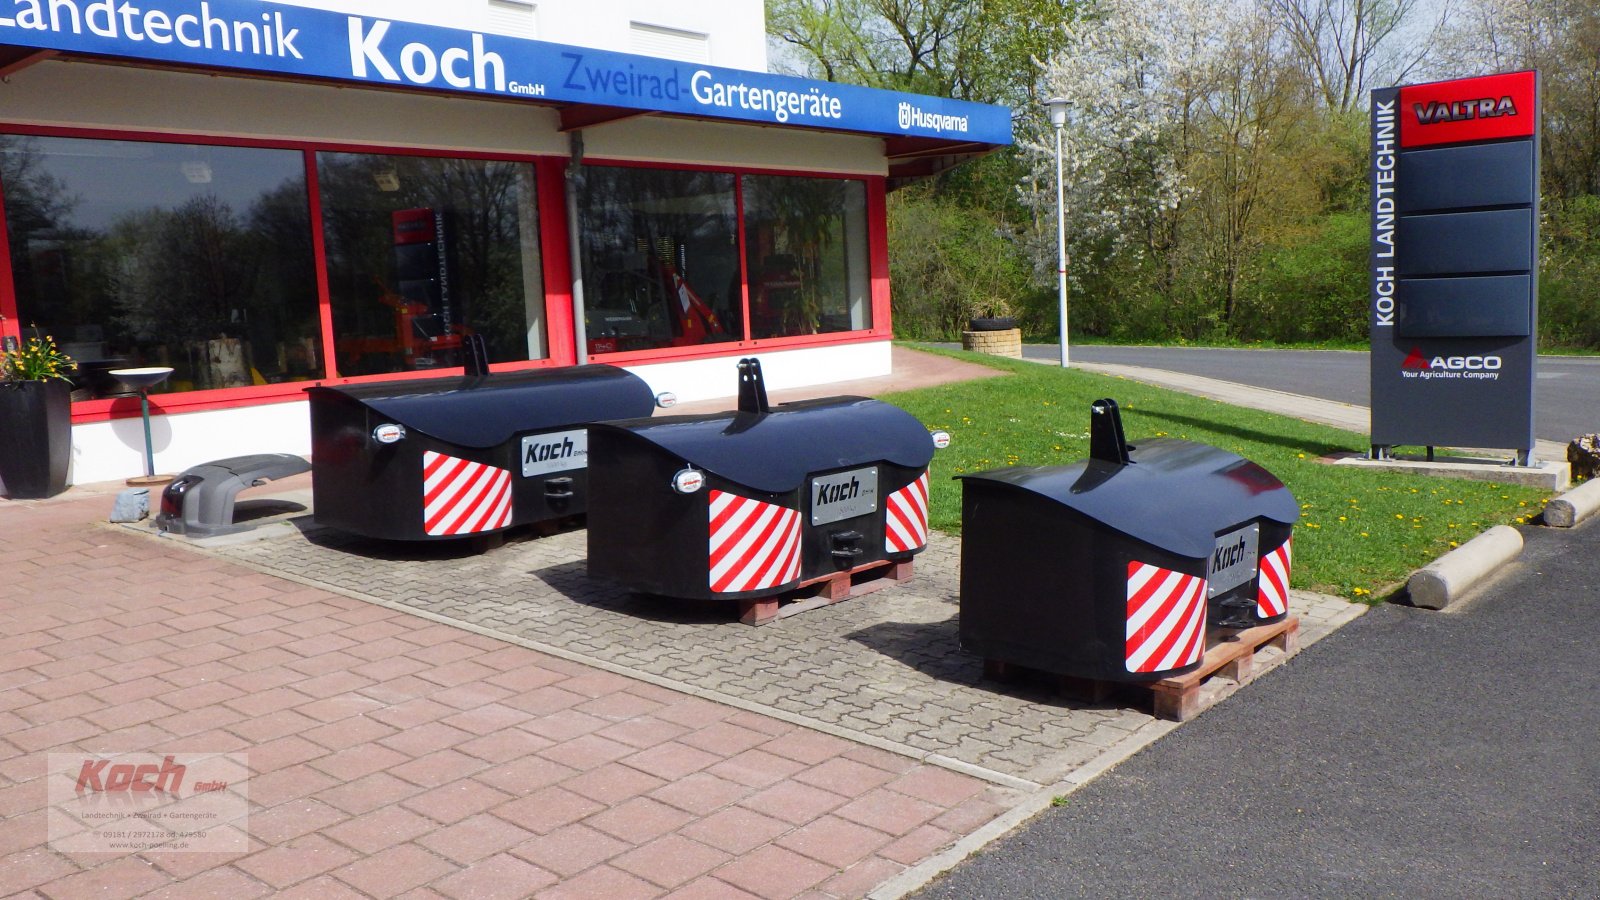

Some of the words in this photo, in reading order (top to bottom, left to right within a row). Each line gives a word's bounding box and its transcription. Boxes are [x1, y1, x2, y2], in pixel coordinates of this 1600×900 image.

[0, 0, 303, 59] andtechnik
[347, 16, 506, 92] Koch
[508, 80, 546, 97] GmbH
[690, 69, 842, 122] Gartengeräte
[911, 106, 968, 132] Husqvarna
[1413, 96, 1518, 125] VALTRA
[1376, 99, 1395, 258] LANDTECHNIK
[1376, 266, 1395, 326] KOCH
[1402, 370, 1419, 379] Your
[1420, 370, 1461, 380] Agriculture
[1463, 370, 1499, 381] Company
[1430, 355, 1502, 370] AGCO
[525, 436, 574, 465] Koch
[816, 475, 860, 506] Koch
[1211, 535, 1246, 574] Koch
